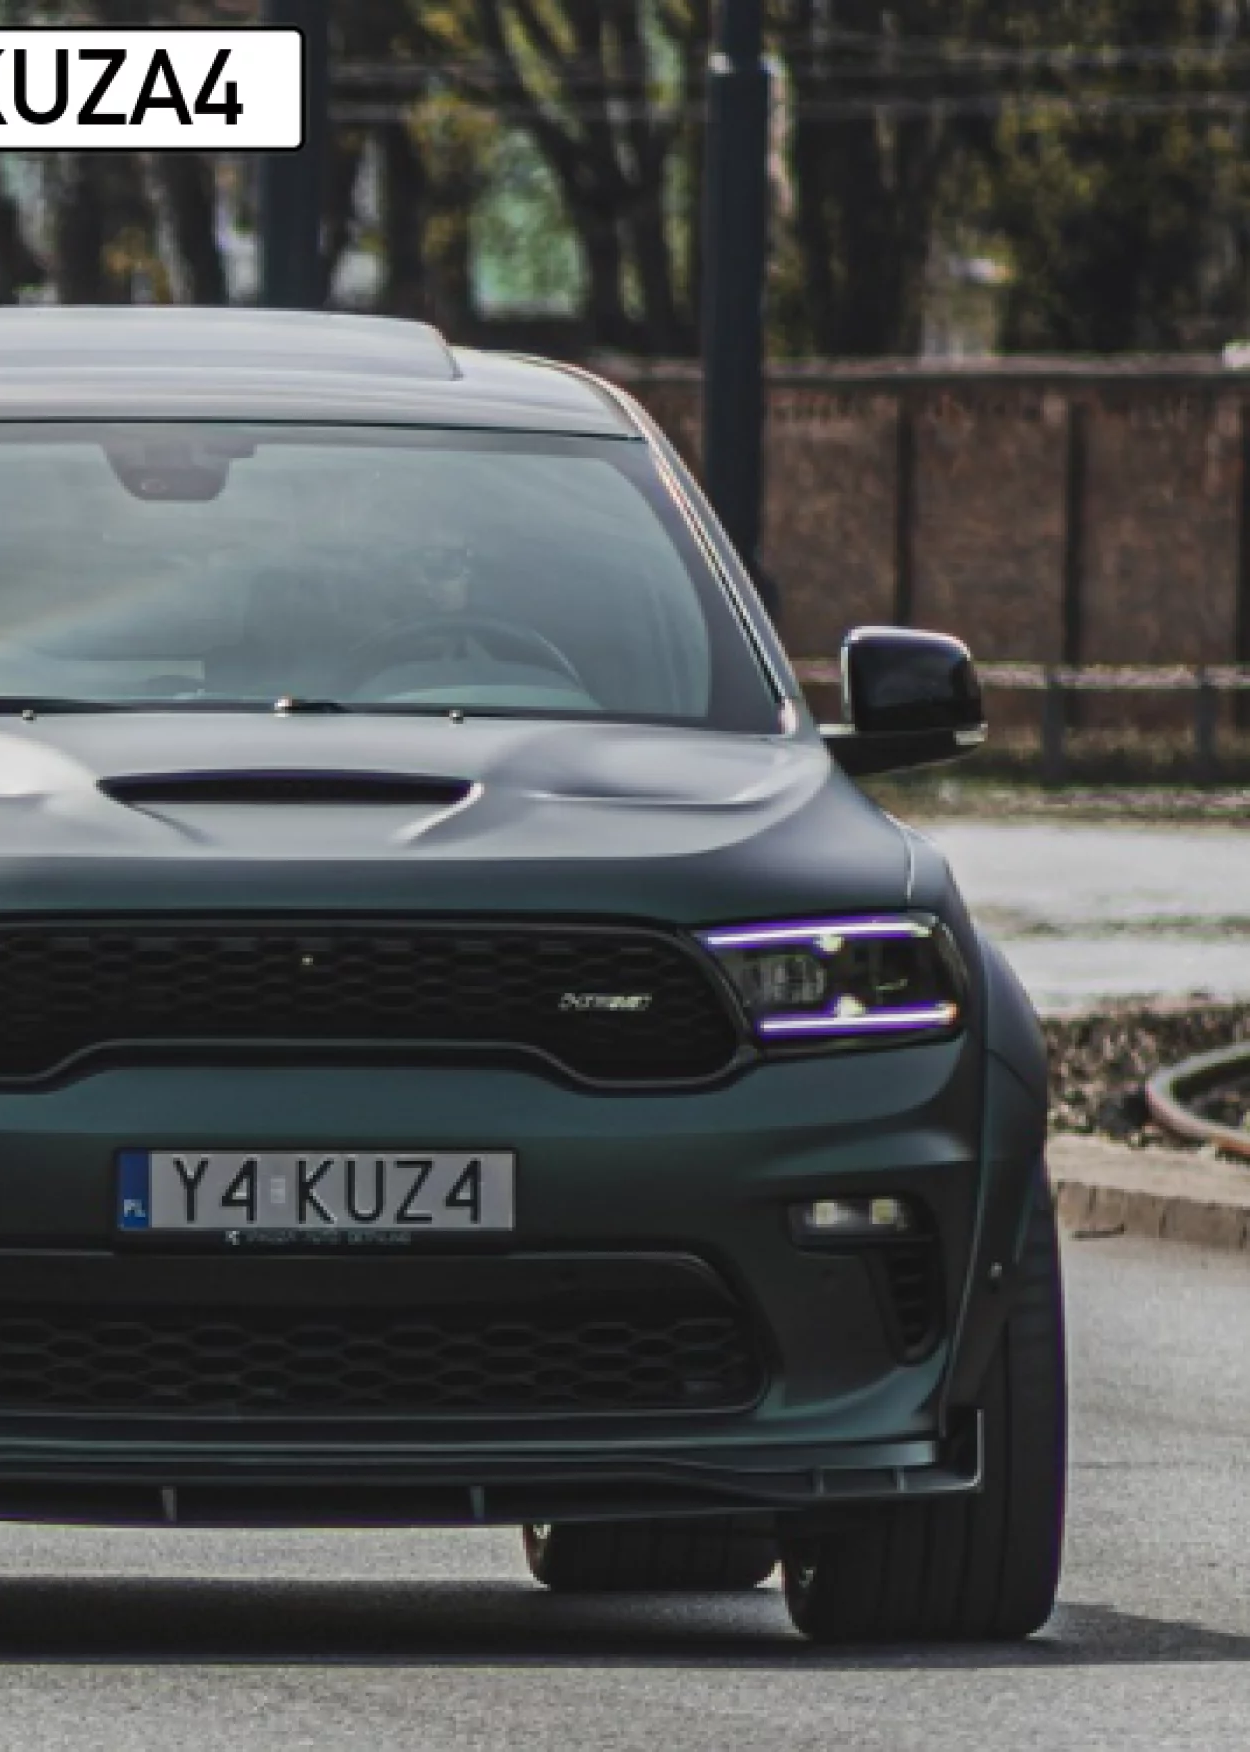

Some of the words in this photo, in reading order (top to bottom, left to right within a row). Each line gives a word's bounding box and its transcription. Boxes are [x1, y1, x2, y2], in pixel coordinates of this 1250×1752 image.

[123, 1199, 146, 1218] PL
[172, 1157, 258, 1223] Y4
[297, 1157, 482, 1224] KUZ4
